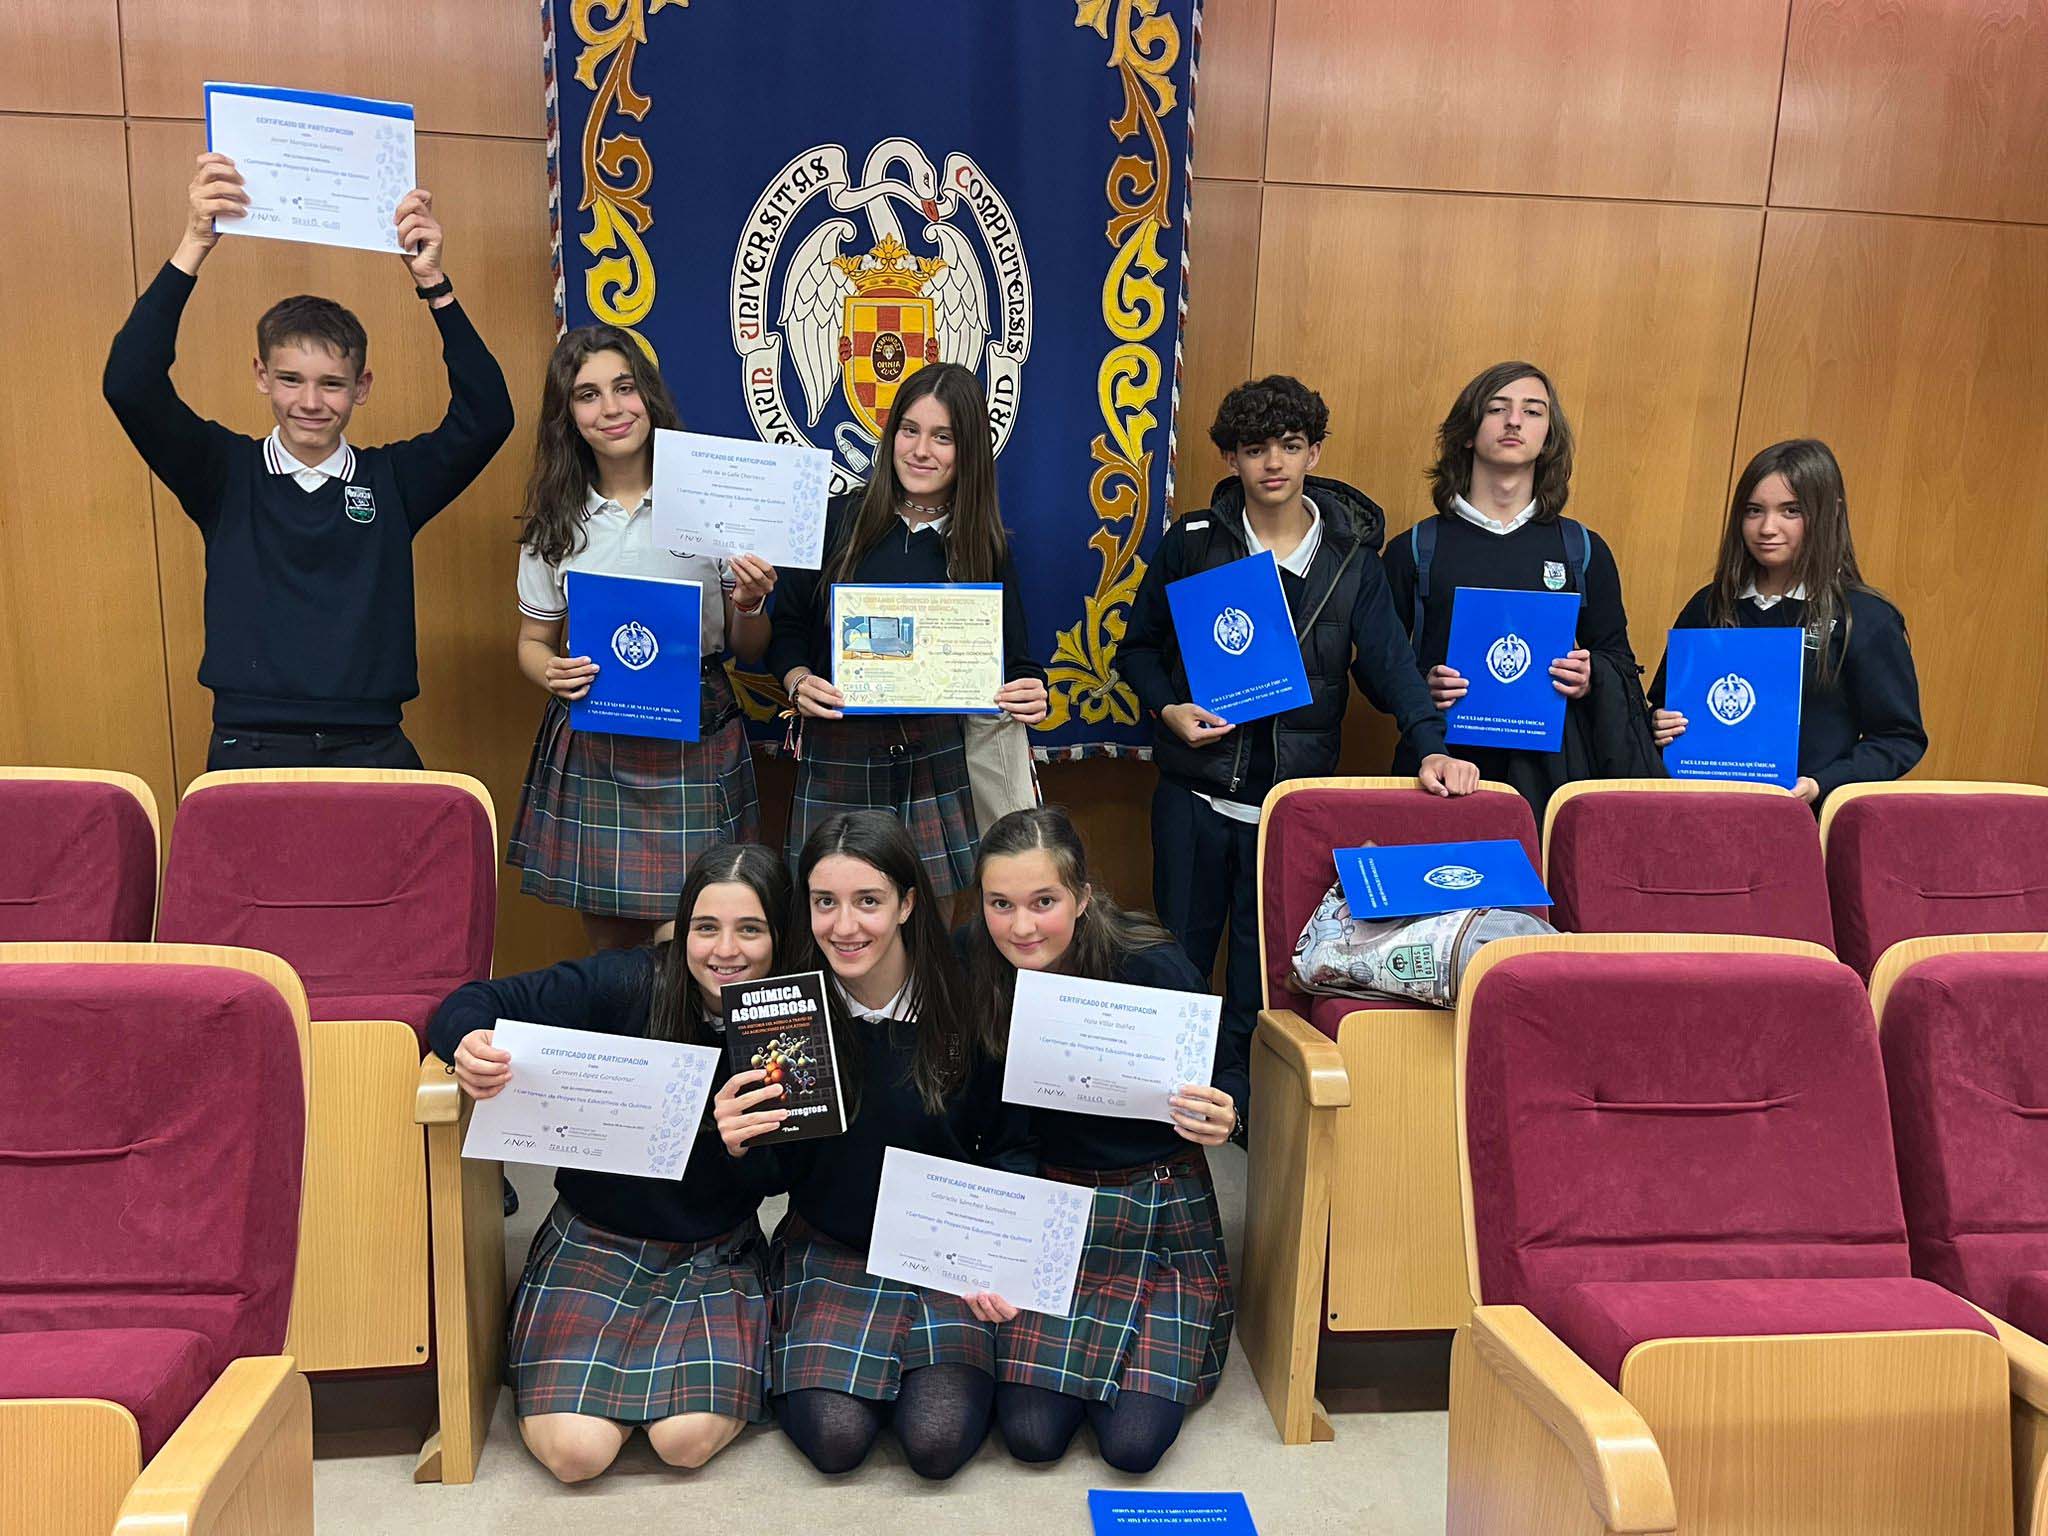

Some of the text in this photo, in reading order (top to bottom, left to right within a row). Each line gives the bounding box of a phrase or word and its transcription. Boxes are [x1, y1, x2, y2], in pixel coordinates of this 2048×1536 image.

[298, 122, 306, 130] DE
[739, 155, 830, 340] UNIVERSITAS
[954, 165, 1027, 356] COMPLUTENSIS
[877, 360, 900, 368] OMNIA
[1414, 952, 1424, 974] SHARE
[1422, 947, 1432, 975] LOVE TO
[741, 985, 802, 1006] QUÍMICA
[1059, 995, 1100, 1007] CERTIFICADO
[731, 998, 818, 1023] ASOMBROSA
[541, 1048, 586, 1059] CERTIFICADO
[552, 1068, 578, 1078] Carmen
[787, 1104, 828, 1116] orregrosa
[926, 1174, 967, 1188] CERTIFICADO
